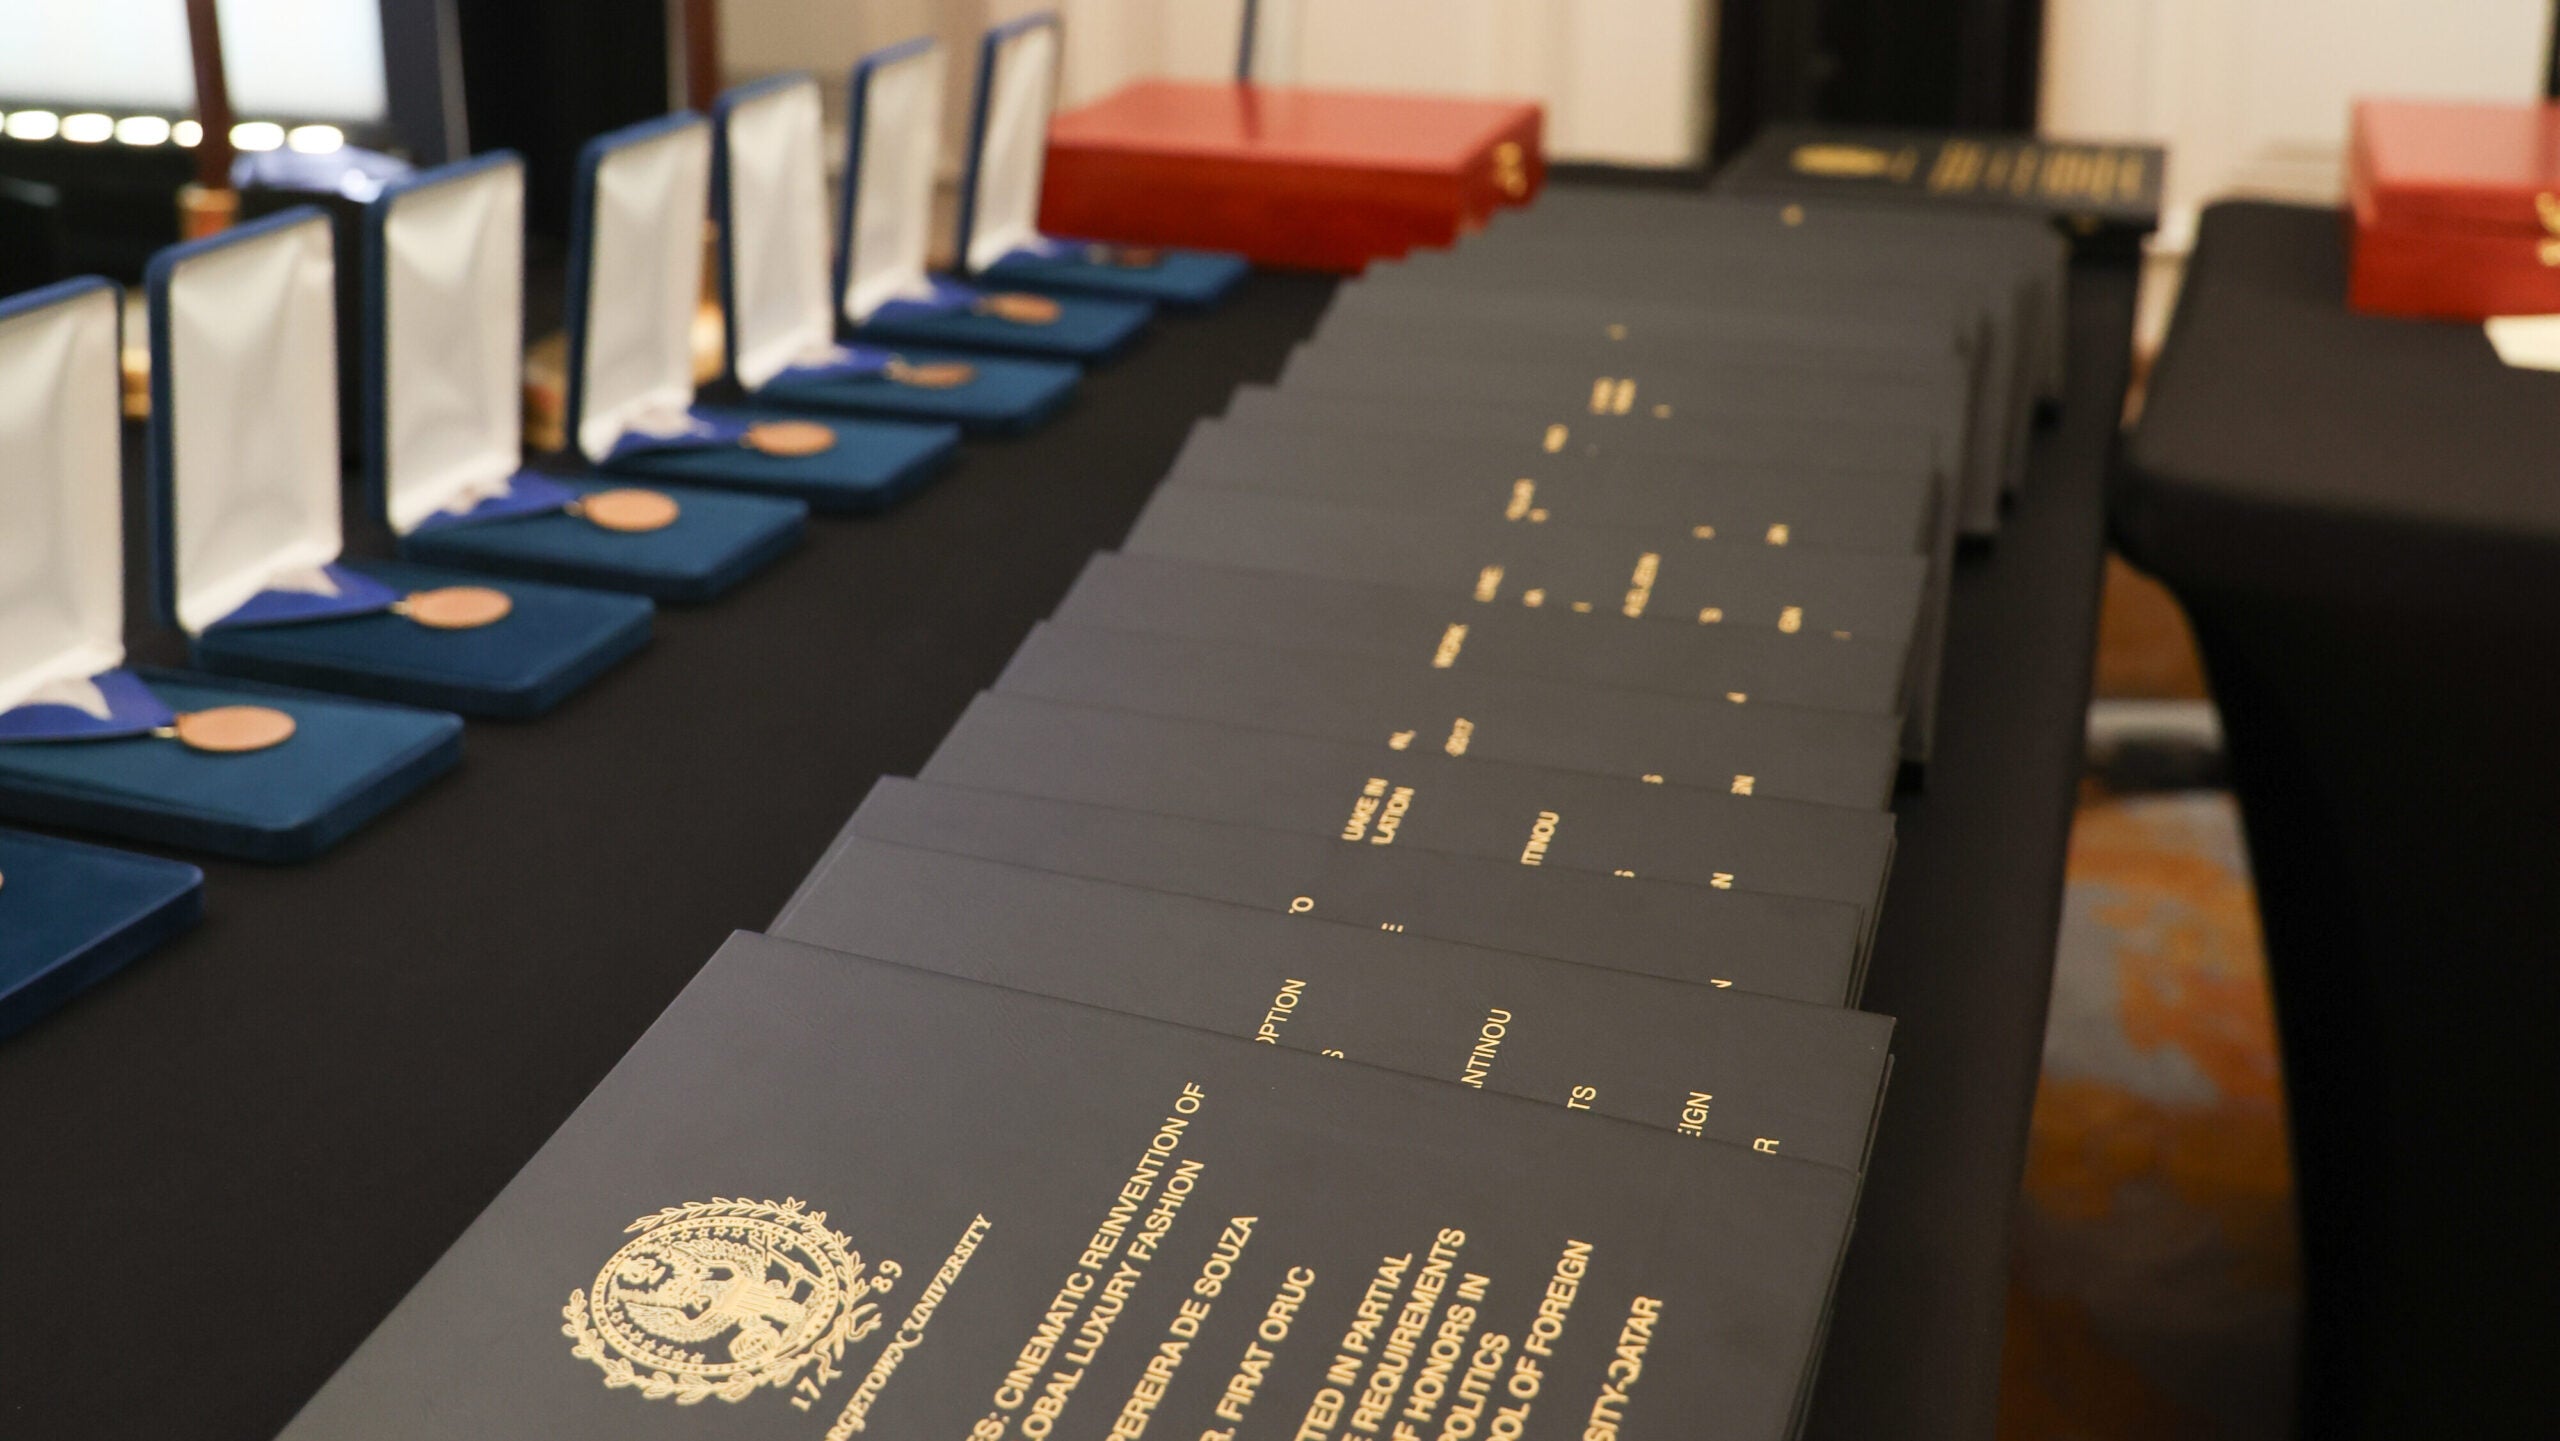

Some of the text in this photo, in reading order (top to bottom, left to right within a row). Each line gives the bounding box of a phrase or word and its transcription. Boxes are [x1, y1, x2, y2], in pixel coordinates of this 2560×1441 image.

[1677, 1091, 1713, 1137] IGN
[902, 1213, 993, 1331] UNIVERSITY
[993, 1271, 1095, 1409] CINEMATIC
[1079, 1117, 1189, 1270] REINVENTION
[1175, 1082, 1205, 1114] OF
[1065, 1261, 1142, 1365] LUXURY
[1127, 1159, 1205, 1260] FASHION
[1169, 1298, 1211, 1339] DE
[1193, 1215, 1259, 1298] SOUZA
[1342, 1251, 1413, 1355] PARTIAL
[1524, 1239, 1594, 1357] FOREIGN
[790, 1259, 902, 1412] 17 89
[1215, 1341, 1275, 1422] FIRAT
[1259, 1265, 1316, 1342] ORUC
[1326, 1354, 1363, 1387] IN
[1351, 1227, 1467, 1433] REQUIREMENTS
[1402, 1303, 1477, 1423] HONORS
[1457, 1272, 1491, 1302] IN
[1508, 1355, 1545, 1399] OF
